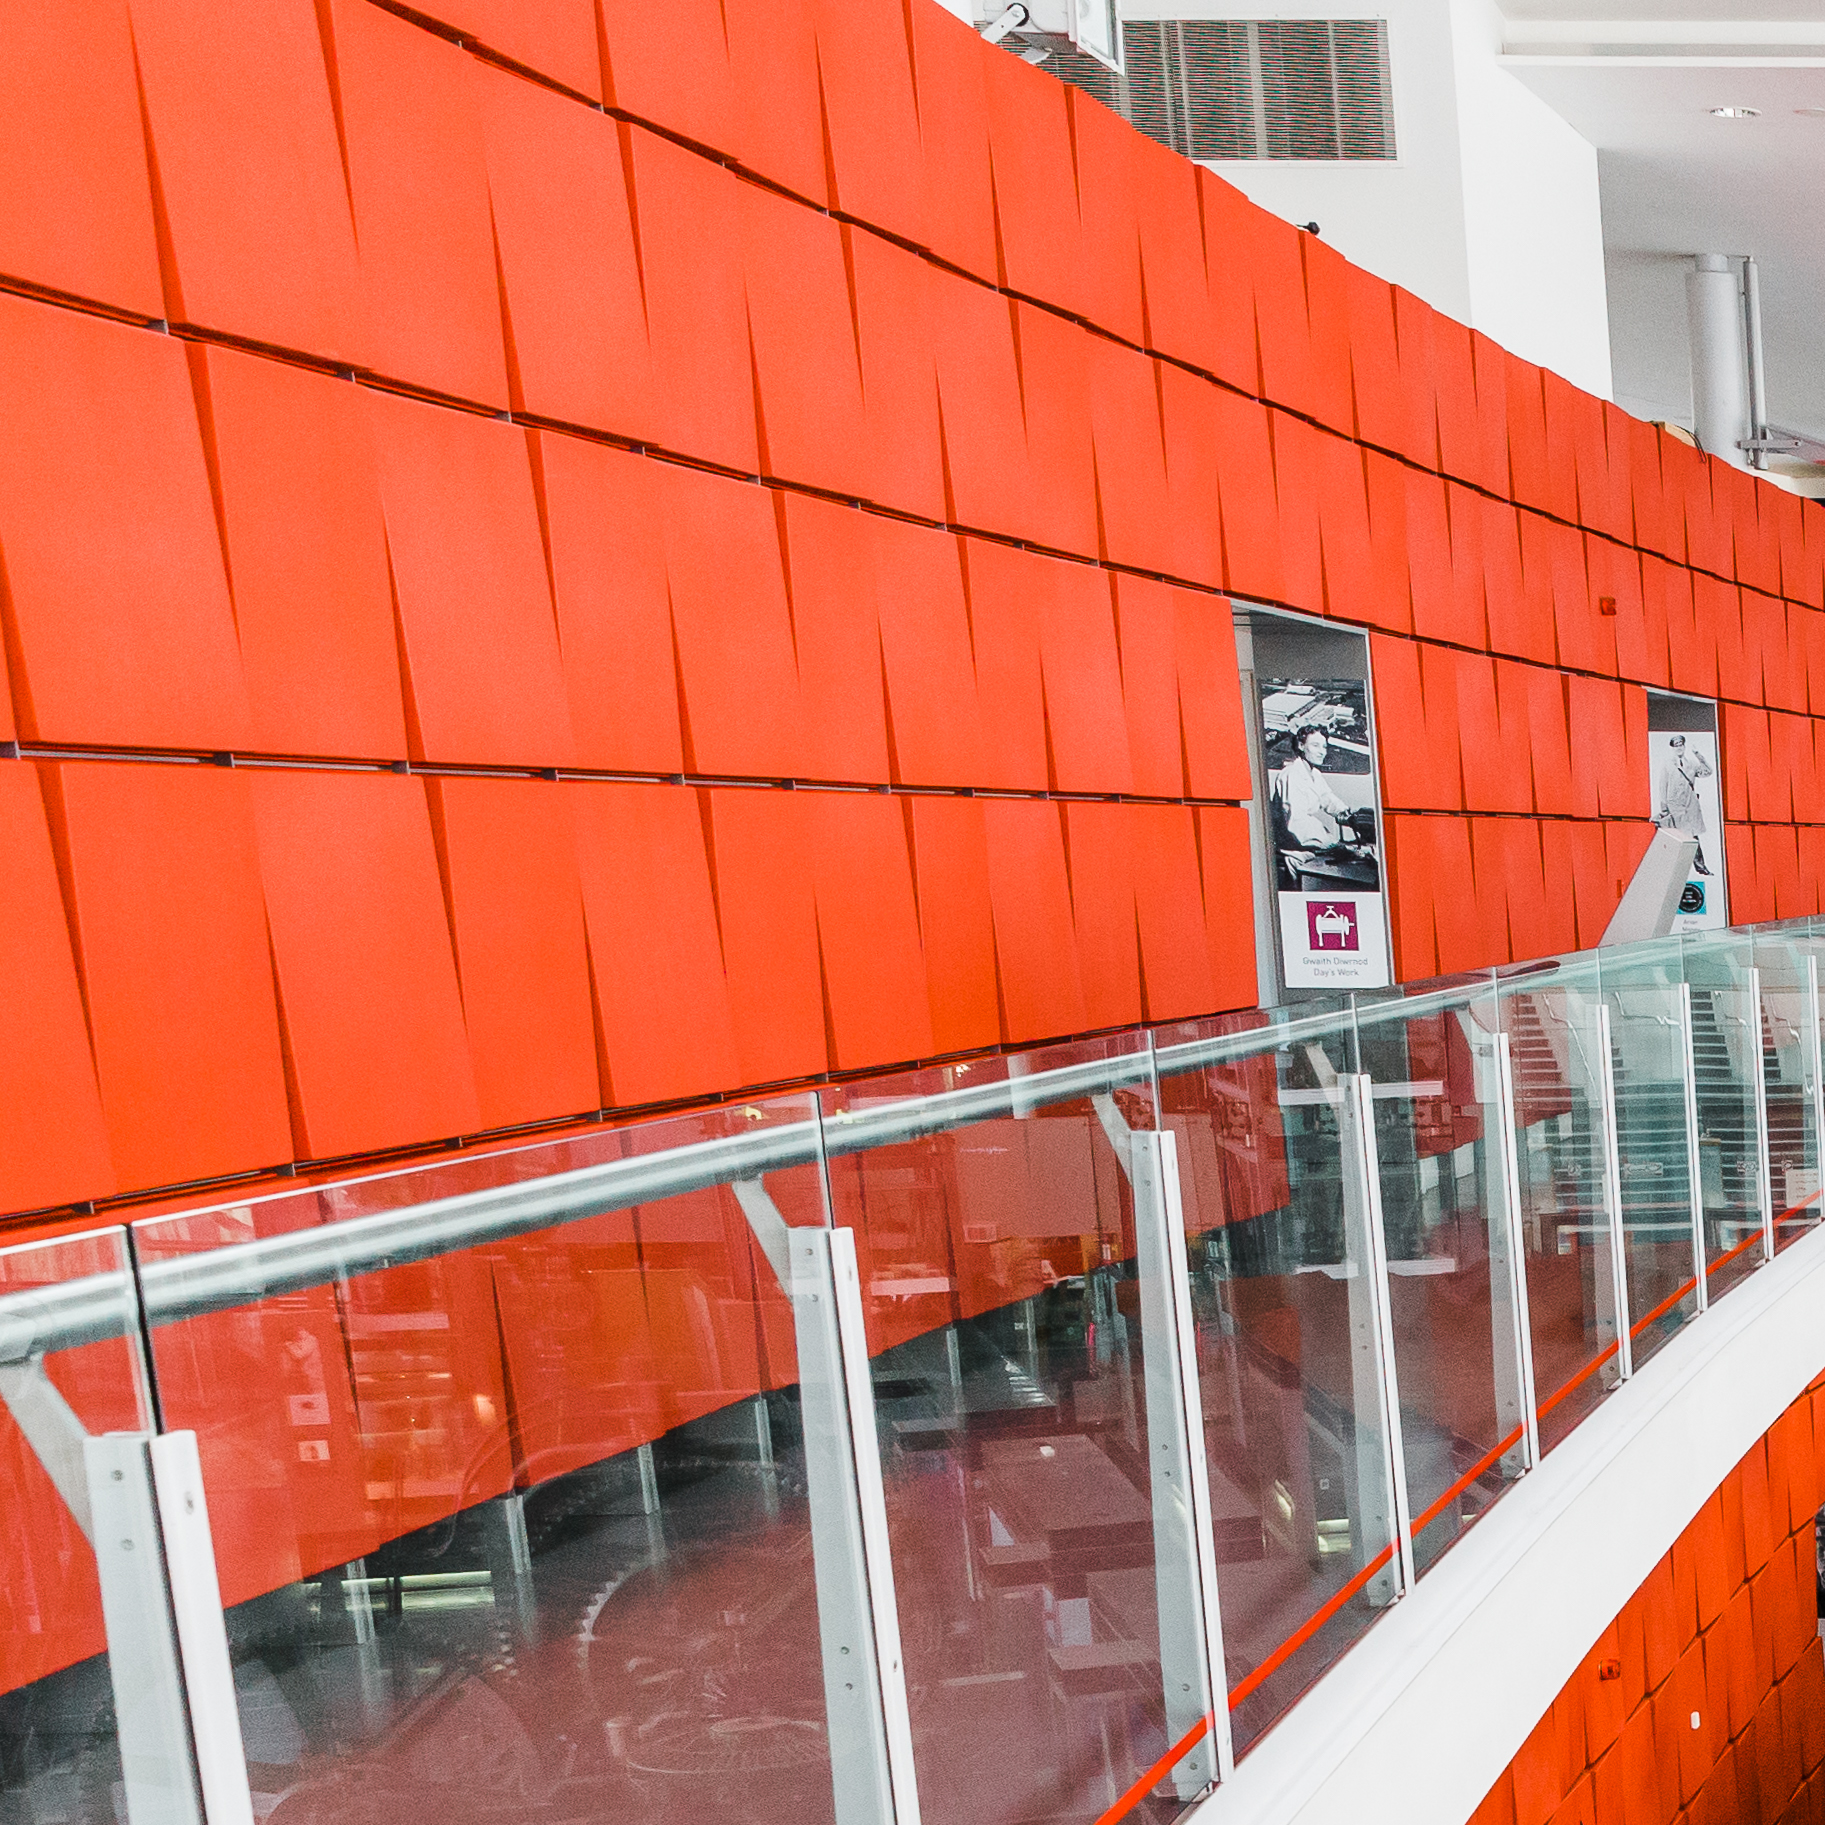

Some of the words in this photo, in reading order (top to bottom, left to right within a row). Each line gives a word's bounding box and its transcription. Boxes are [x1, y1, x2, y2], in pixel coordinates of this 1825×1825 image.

[1302, 956, 1332, 966] Gwaith
[1313, 968, 1335, 978] Day's
[1338, 968, 1360, 977] Work
